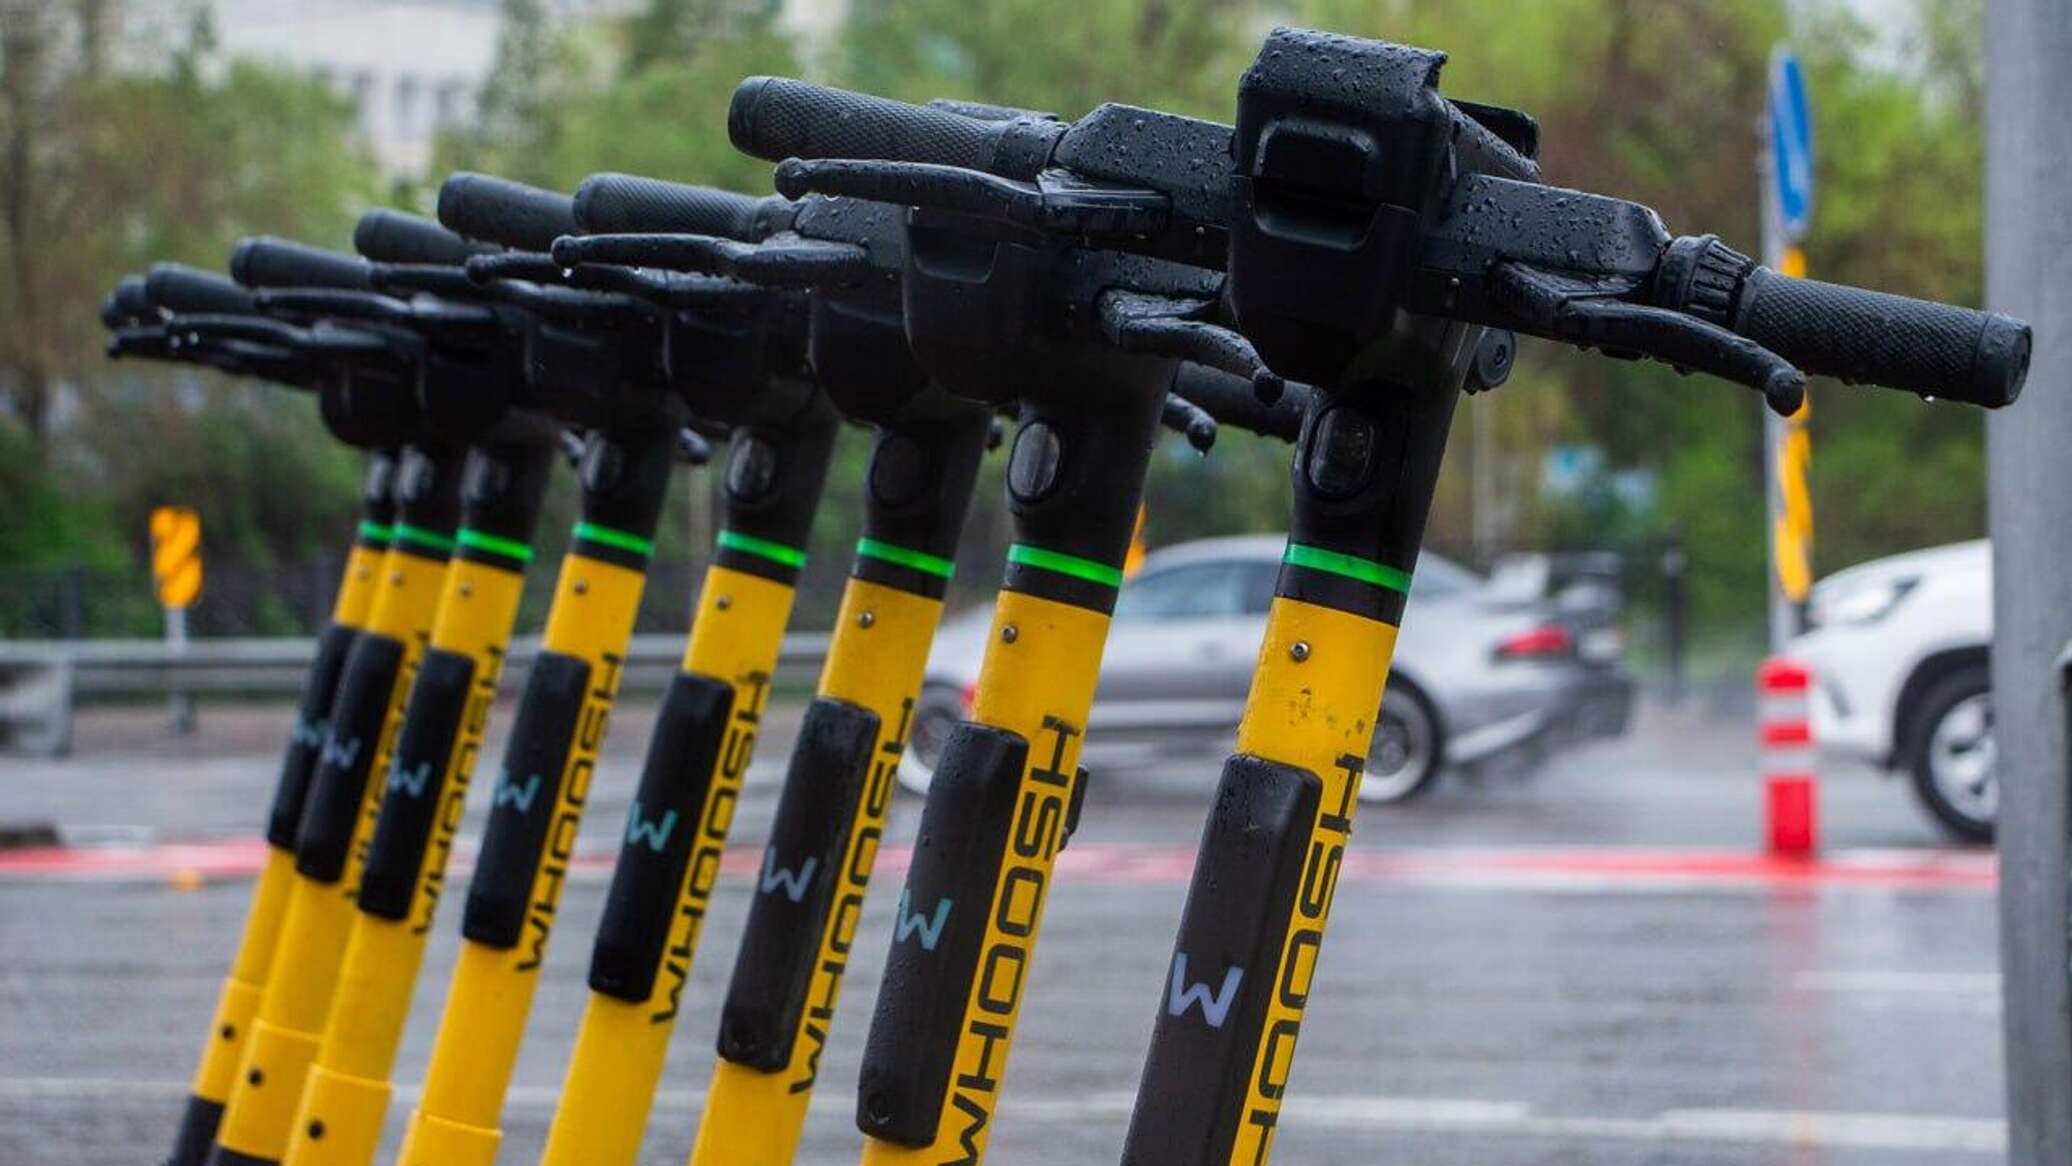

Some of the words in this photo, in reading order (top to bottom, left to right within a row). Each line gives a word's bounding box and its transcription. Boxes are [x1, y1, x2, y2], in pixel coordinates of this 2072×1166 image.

[388, 752, 431, 796] W
[496, 767, 541, 814] W
[515, 653, 622, 972] WHOOSH
[626, 801, 678, 850] W
[651, 671, 768, 1023] WHOOSH
[760, 846, 816, 903] W
[789, 697, 913, 1094] WHOOSH
[895, 888, 952, 951] W
[938, 715, 1080, 1166] WHOOSH
[1169, 952, 1244, 1028] W
